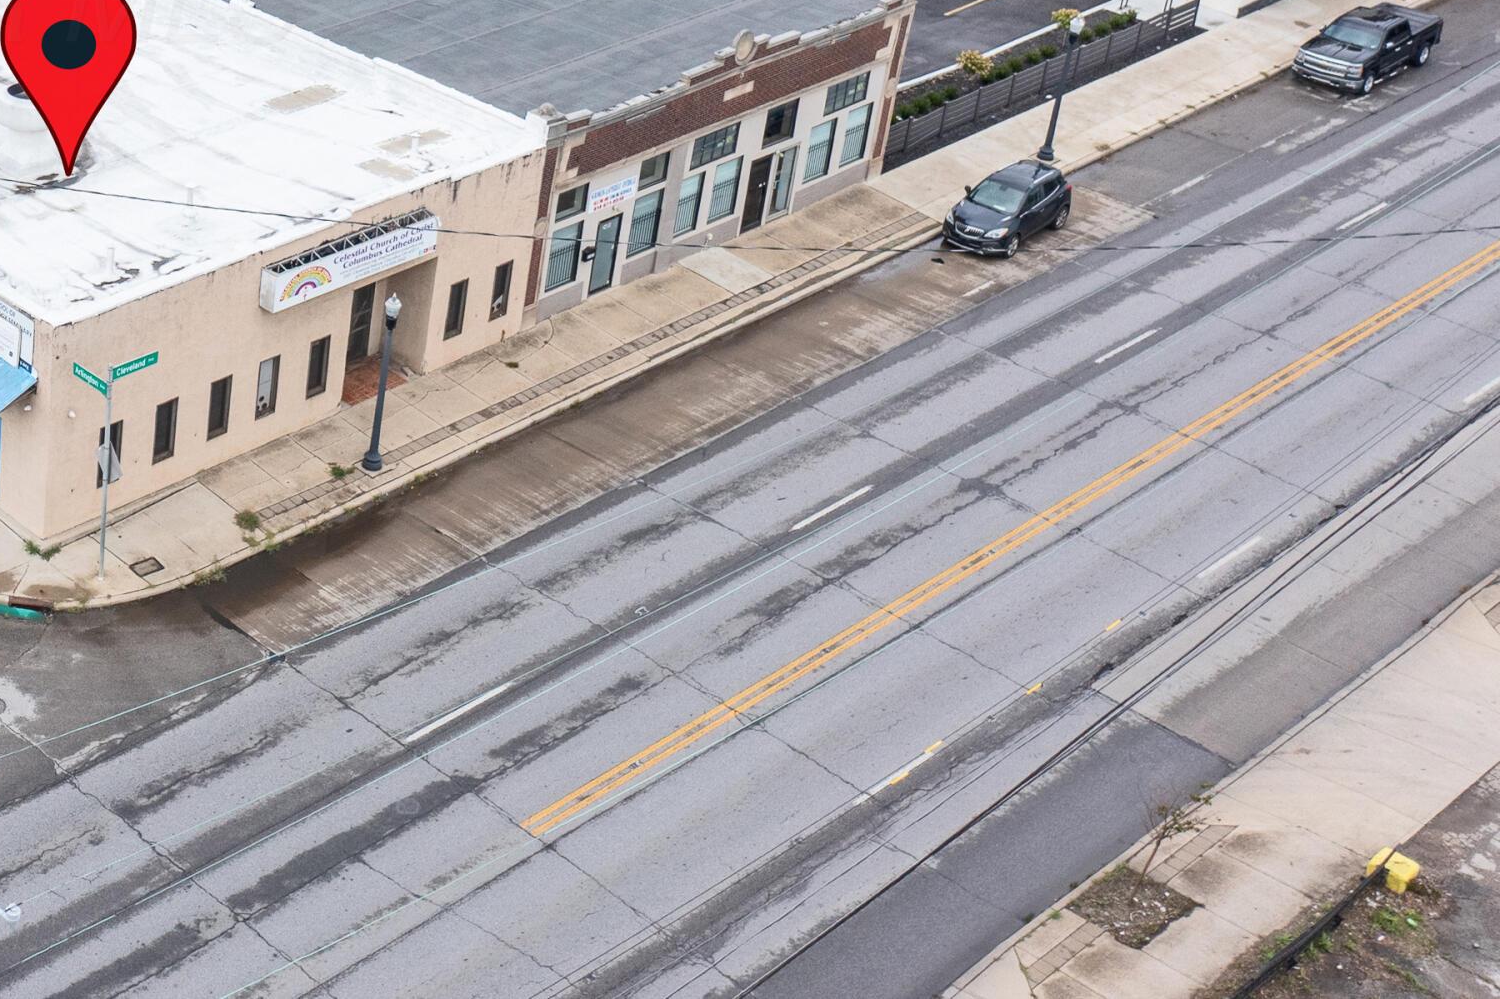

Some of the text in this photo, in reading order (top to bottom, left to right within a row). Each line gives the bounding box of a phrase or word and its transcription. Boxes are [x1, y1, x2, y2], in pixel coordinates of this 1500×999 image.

[333, 222, 434, 265] Celestial Church of Christ
[343, 250, 383, 269] Columbus
[385, 233, 423, 254] Cathedral
[75, 366, 100, 388] Arlington
[116, 358, 146, 377] Cleveland
[82, 671, 103, 682] BLD
